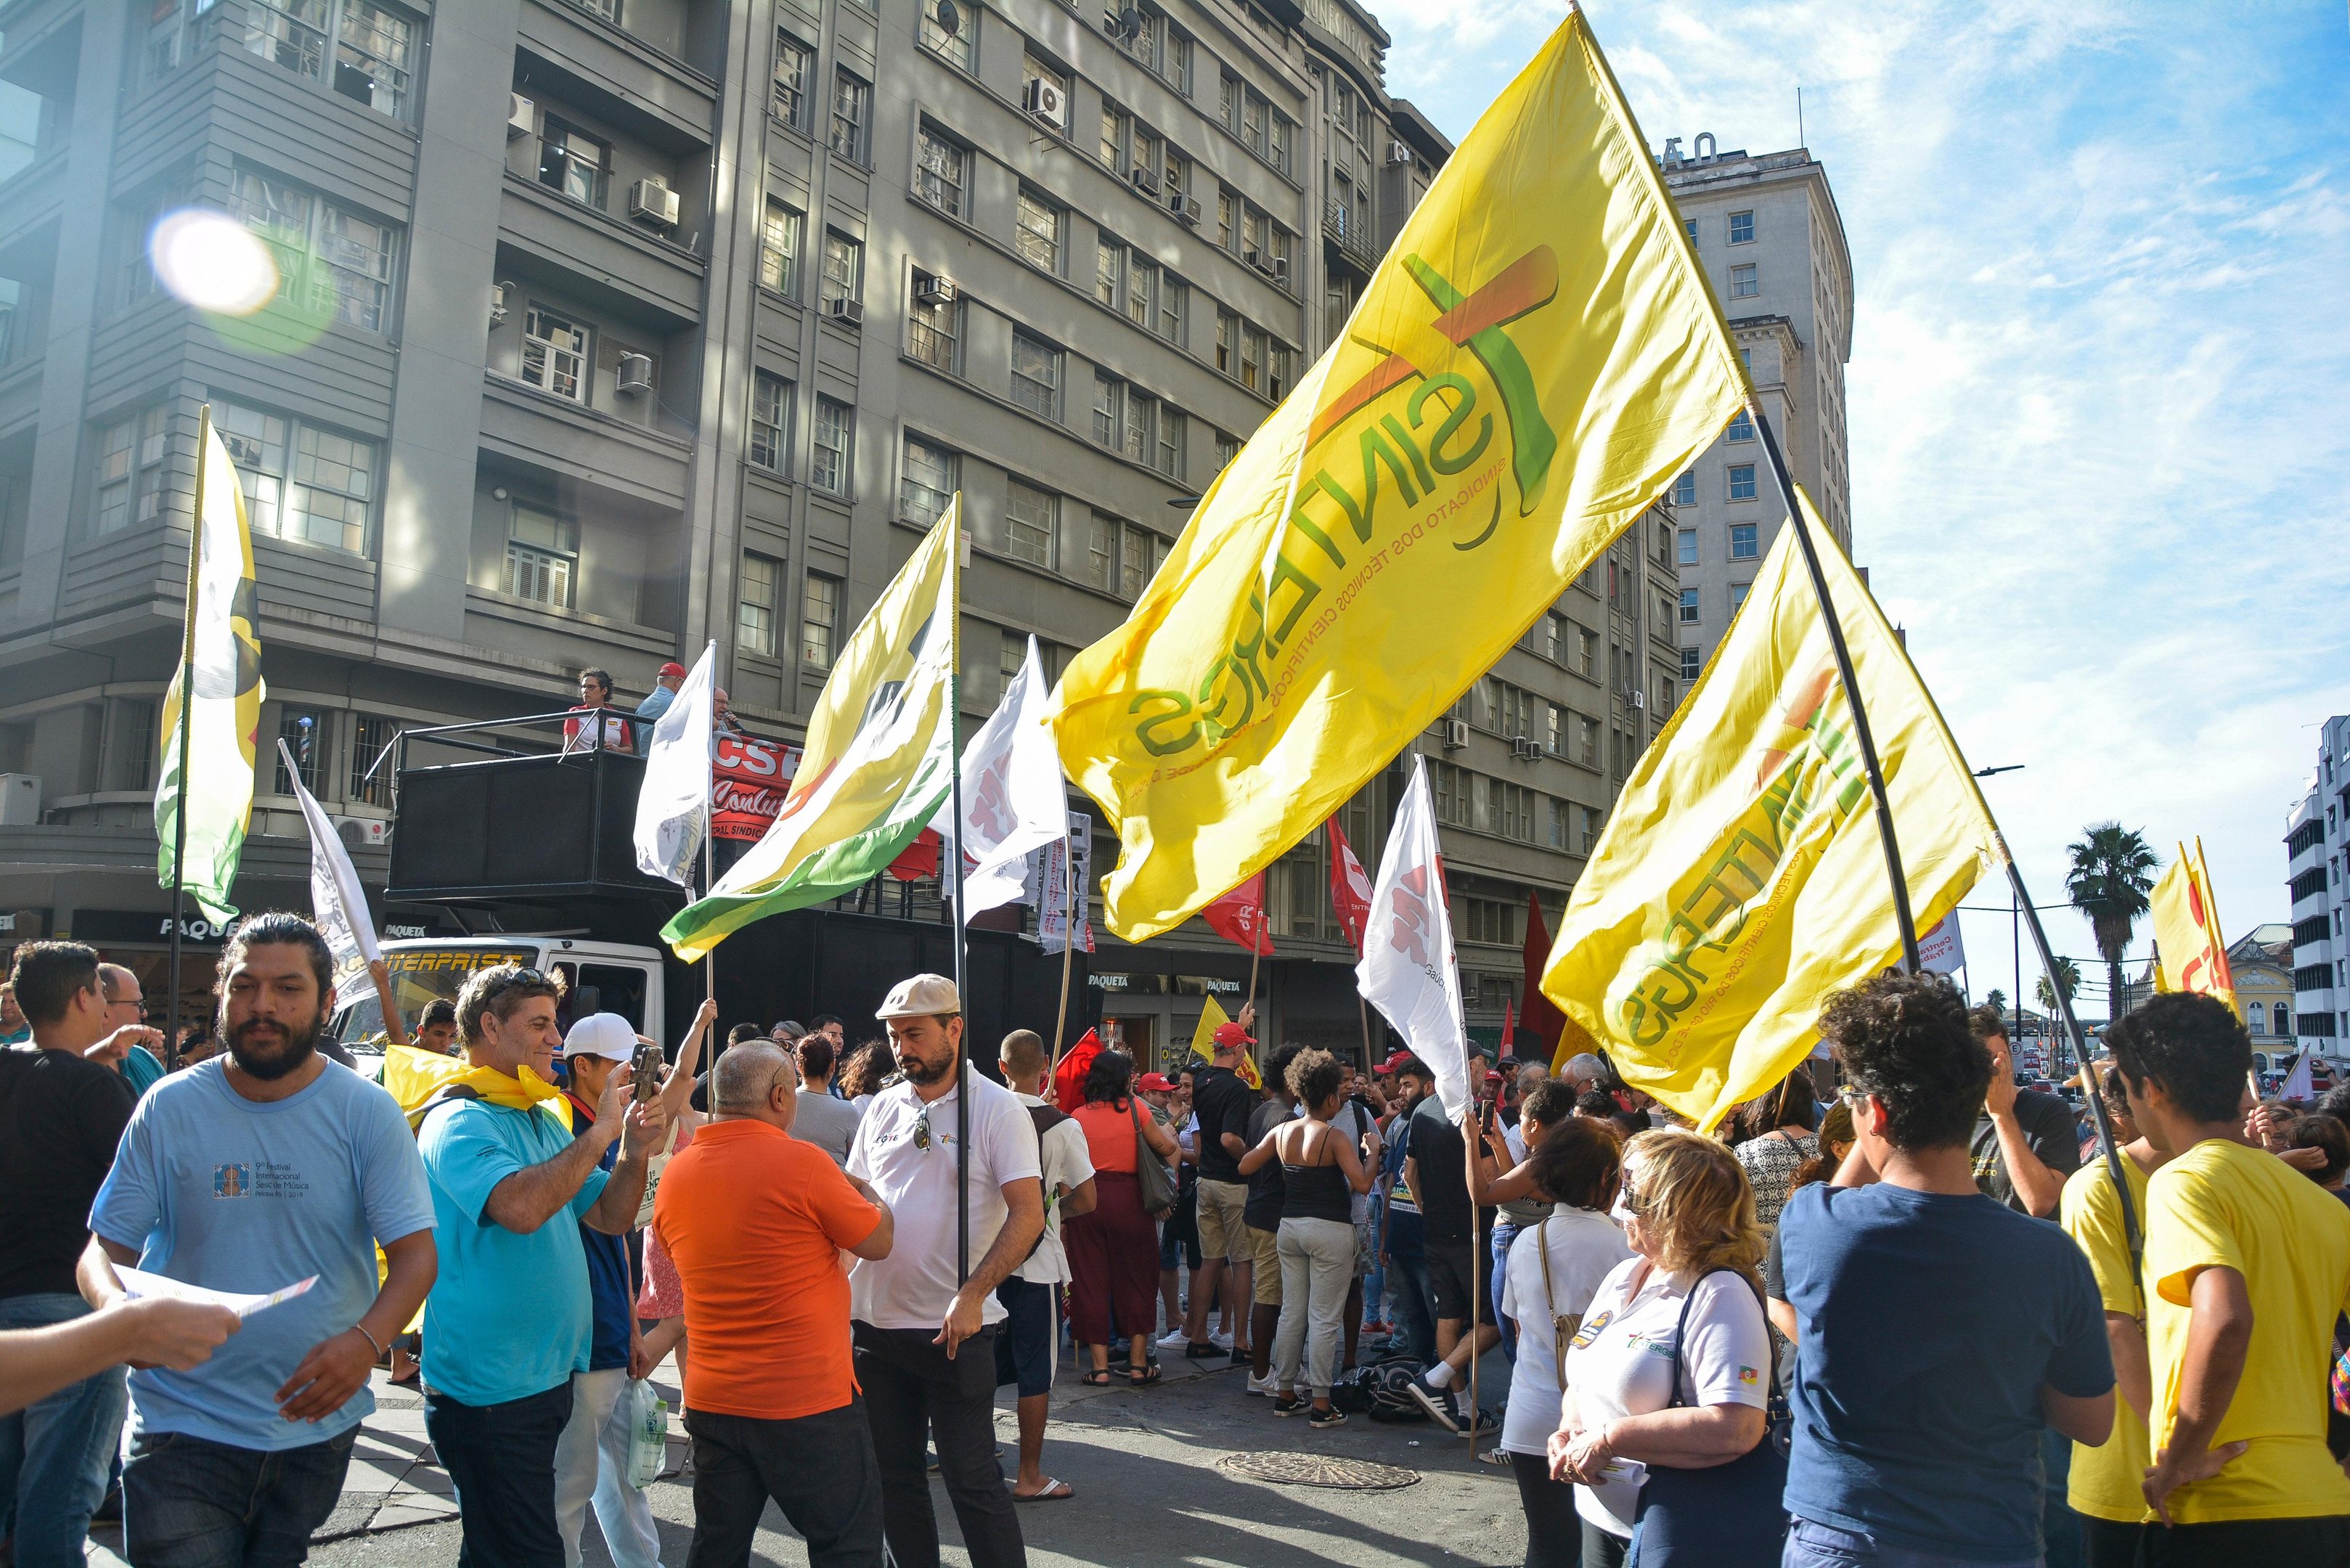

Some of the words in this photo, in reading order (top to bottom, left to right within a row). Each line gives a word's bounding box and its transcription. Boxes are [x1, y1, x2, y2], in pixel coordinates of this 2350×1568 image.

[1089, 974, 1128, 988] PAQUETÁ
[1207, 980, 1240, 992] PAQUETÁ
[1522, 1196, 1538, 1207] LOVE
